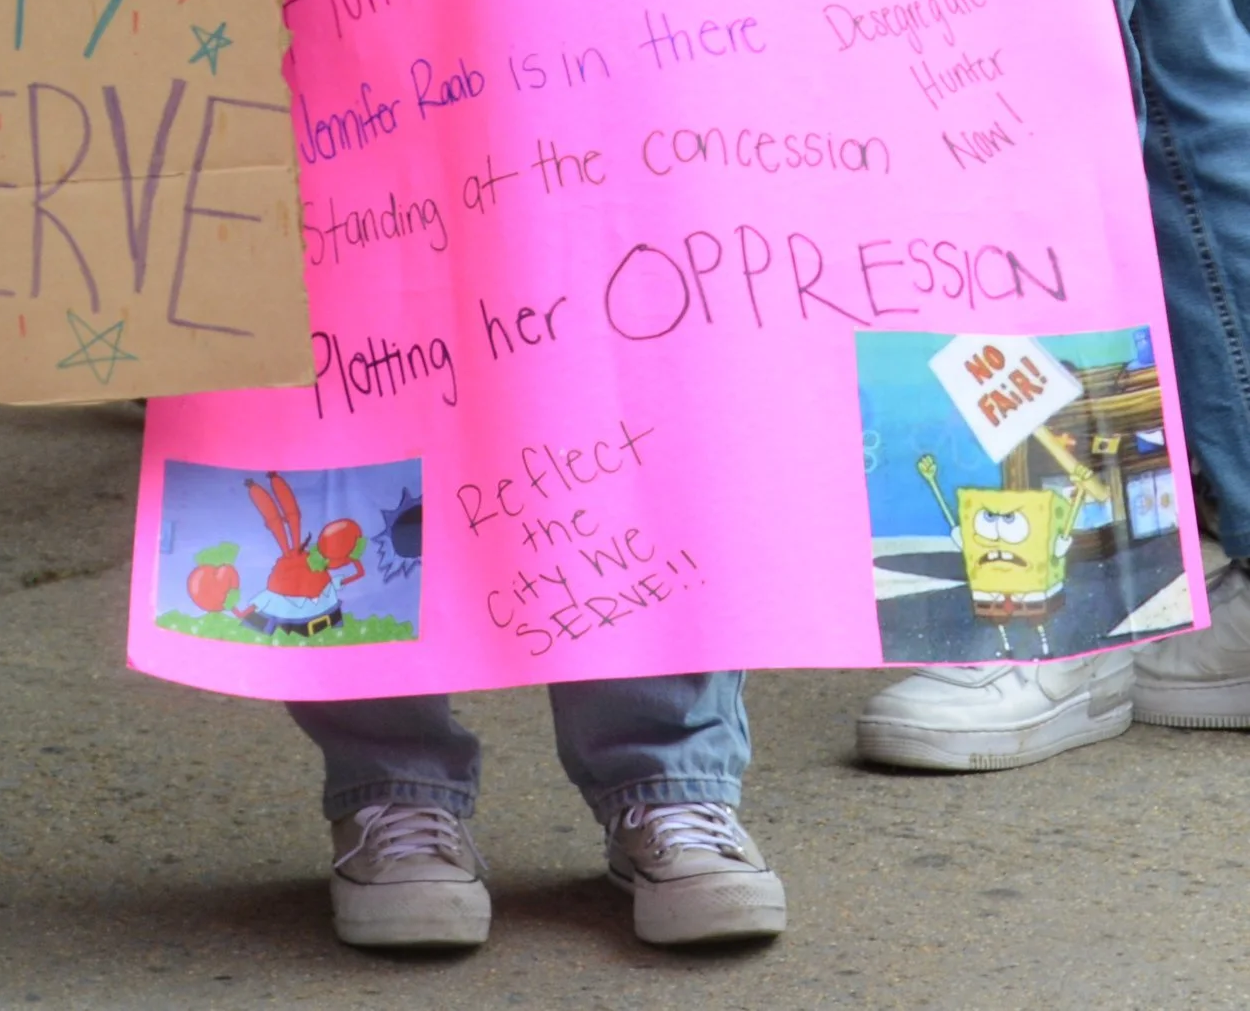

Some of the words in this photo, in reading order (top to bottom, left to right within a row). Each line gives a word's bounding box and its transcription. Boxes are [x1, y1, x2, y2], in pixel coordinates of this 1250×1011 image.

[410, 57, 485, 121] Raab
[562, 41, 610, 87] in
[639, 9, 766, 69] there
[909, 48, 1005, 111] Hunter
[463, 155, 519, 214] at
[531, 139, 606, 194] the
[642, 127, 889, 175] concession
[310, 331, 457, 420] Plotting
[479, 297, 566, 360] her
[605, 224, 1067, 340] OPPRESSION
[963, 344, 1006, 386] NO
[457, 420, 654, 536] Reflect
[522, 508, 599, 552] the
[516, 550, 706, 656] SERVE!!
